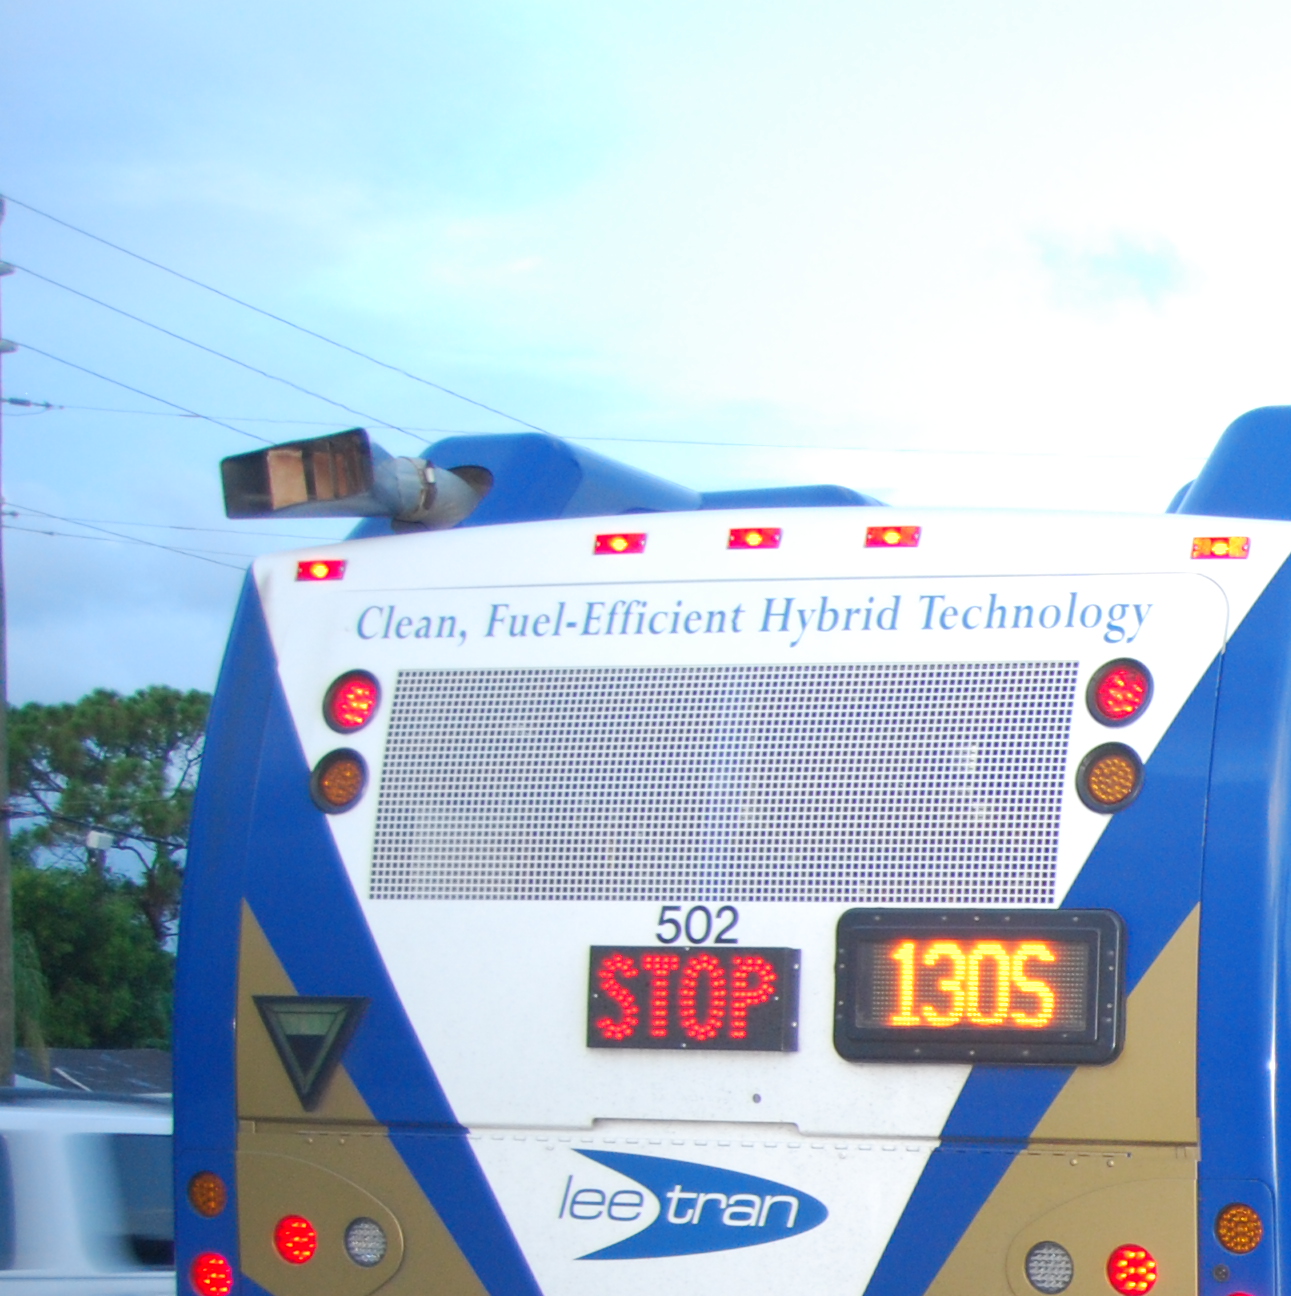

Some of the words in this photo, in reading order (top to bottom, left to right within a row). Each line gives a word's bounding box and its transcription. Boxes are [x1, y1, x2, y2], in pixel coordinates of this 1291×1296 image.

[357, 604, 467, 647] Clean,
[484, 600, 746, 638] Fuel-Efficient
[759, 595, 901, 648] Hybrid
[919, 592, 1154, 644] Technology
[656, 906, 739, 944] 502
[597, 954, 776, 1041] STOP
